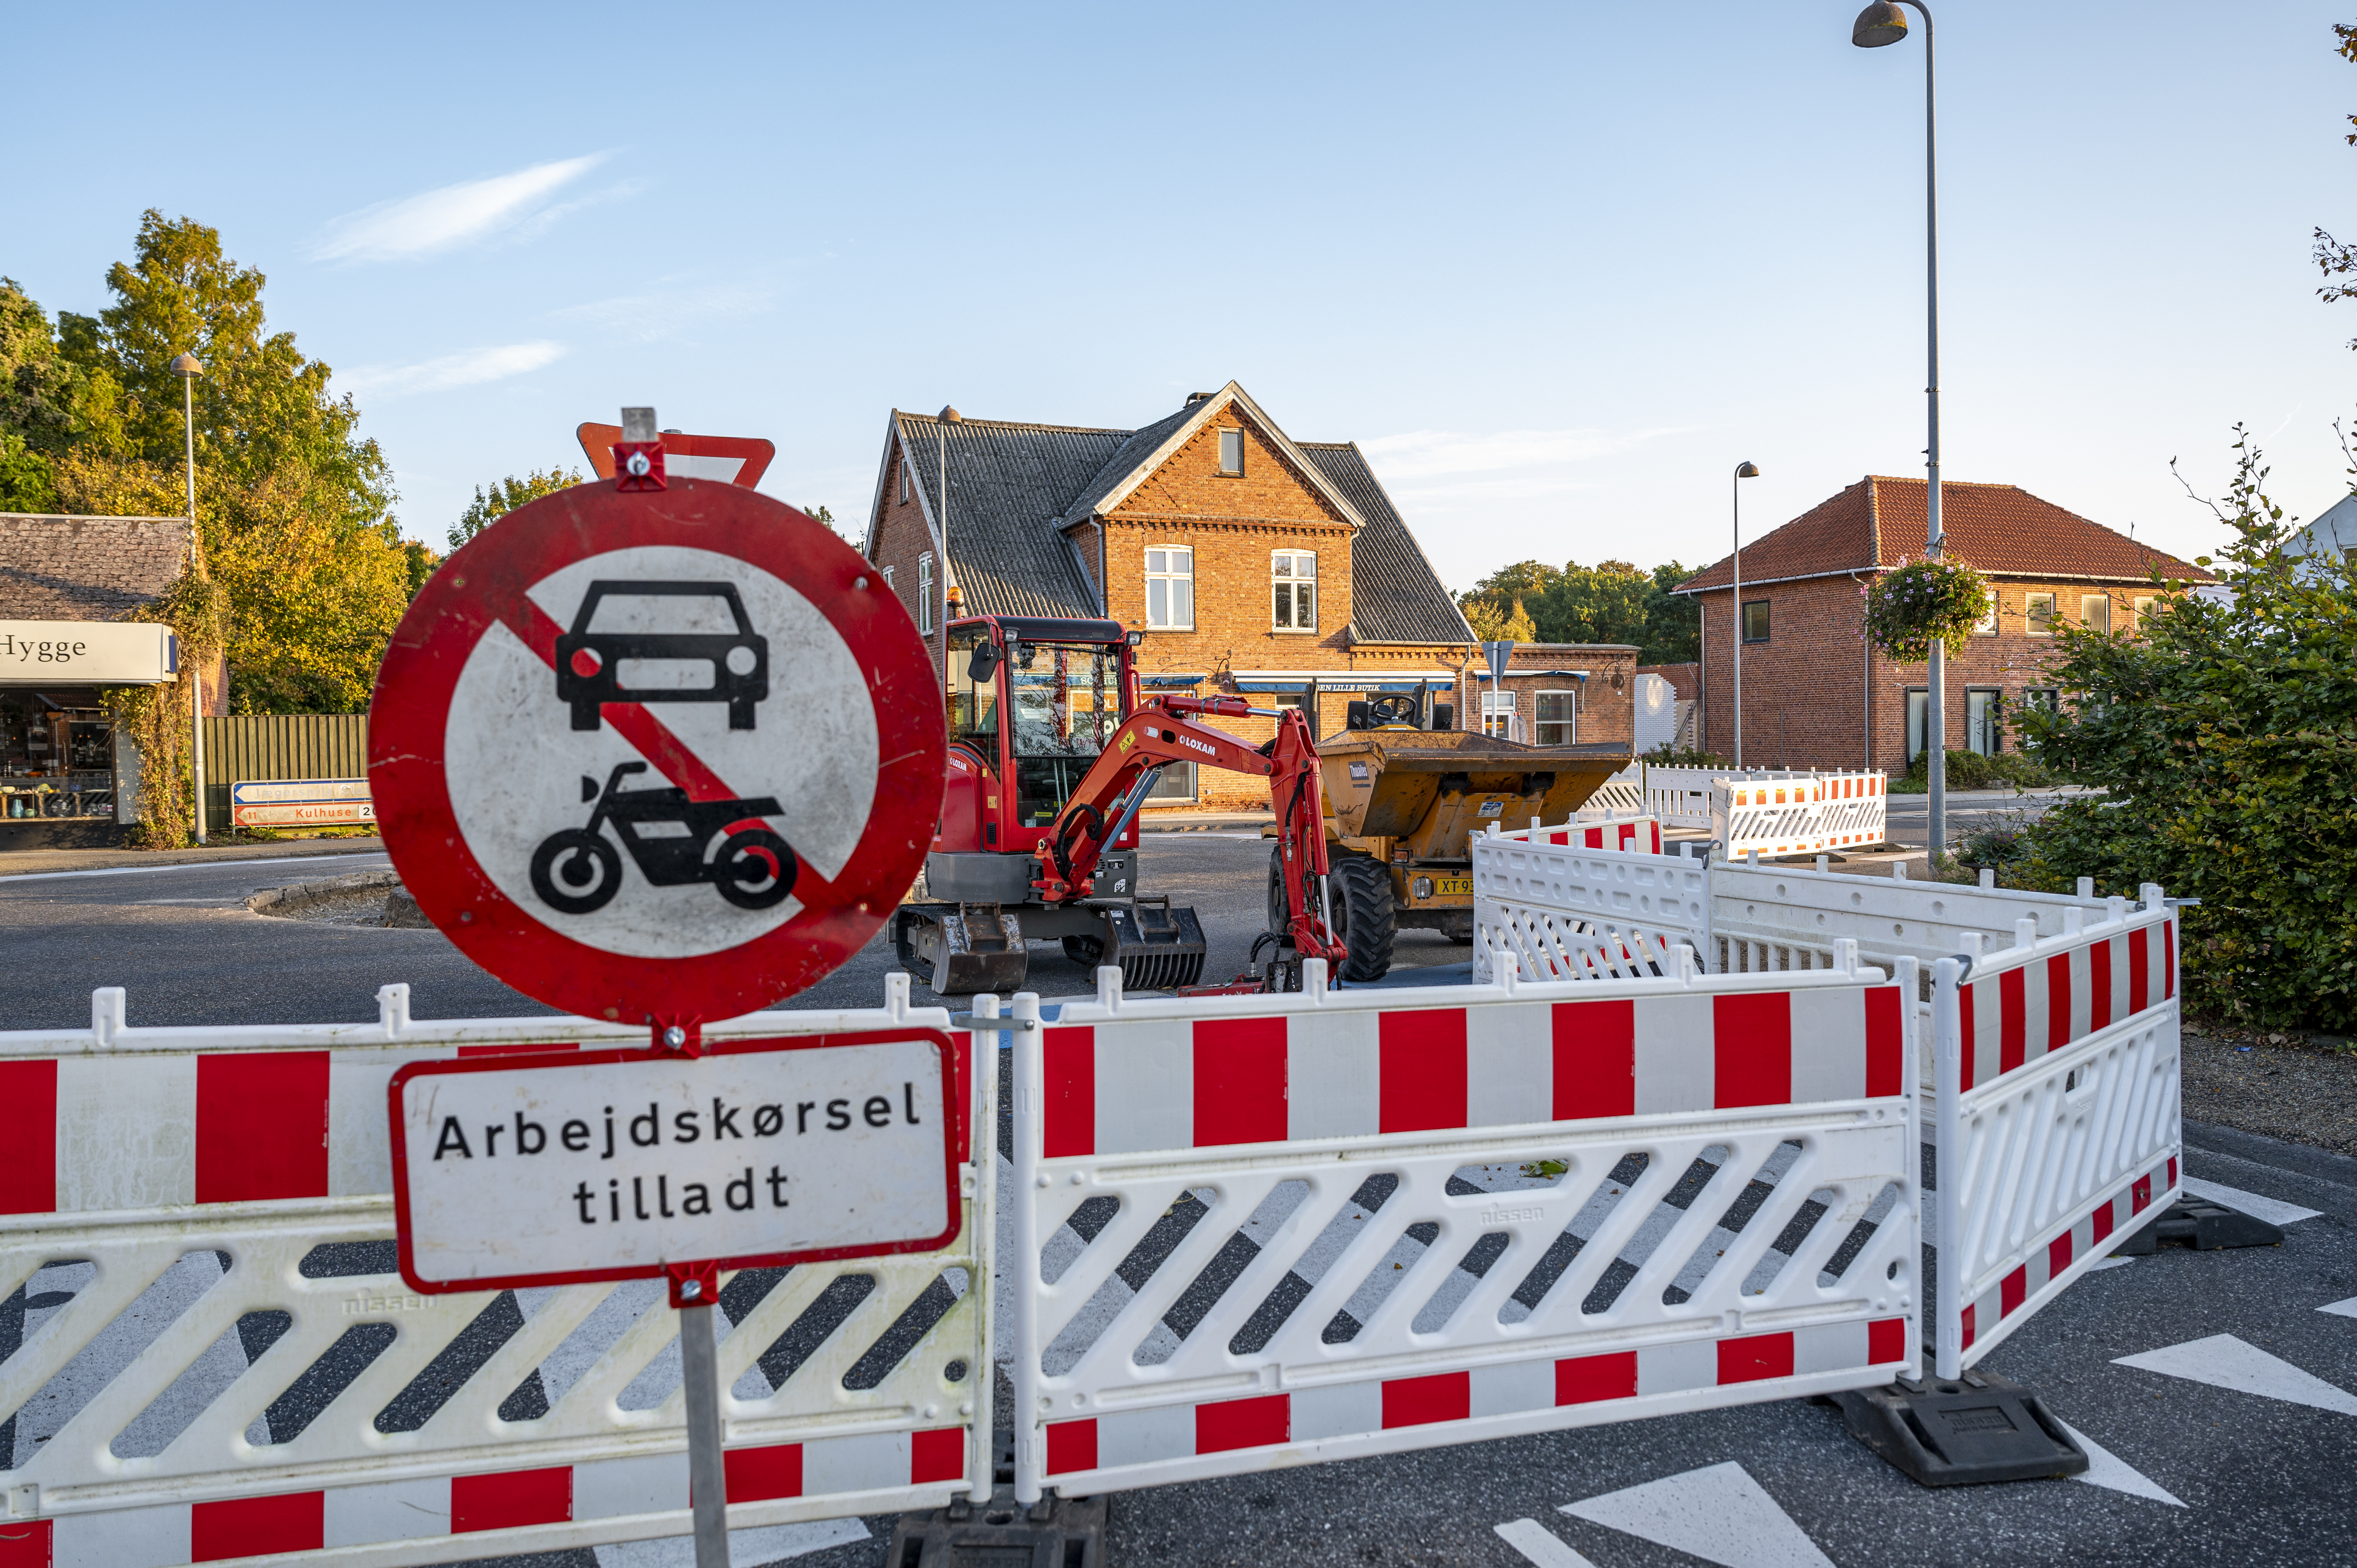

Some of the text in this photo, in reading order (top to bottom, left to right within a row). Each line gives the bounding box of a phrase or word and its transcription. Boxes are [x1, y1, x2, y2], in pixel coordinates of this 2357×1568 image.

[0, 635, 86, 662] Hygge
[1186, 737, 1216, 756] LOXAM
[953, 758, 966, 771] LOXAM
[1349, 765, 1368, 777] Thwaites
[255, 786, 370, 799] Jægerspris Slot
[295, 808, 352, 818] Kulhuse
[1442, 881, 1458, 892] XT
[433, 1081, 921, 1161] Arbejdskørsel
[573, 1164, 789, 1224] tilladt
[1480, 1202, 1543, 1225] nissen
